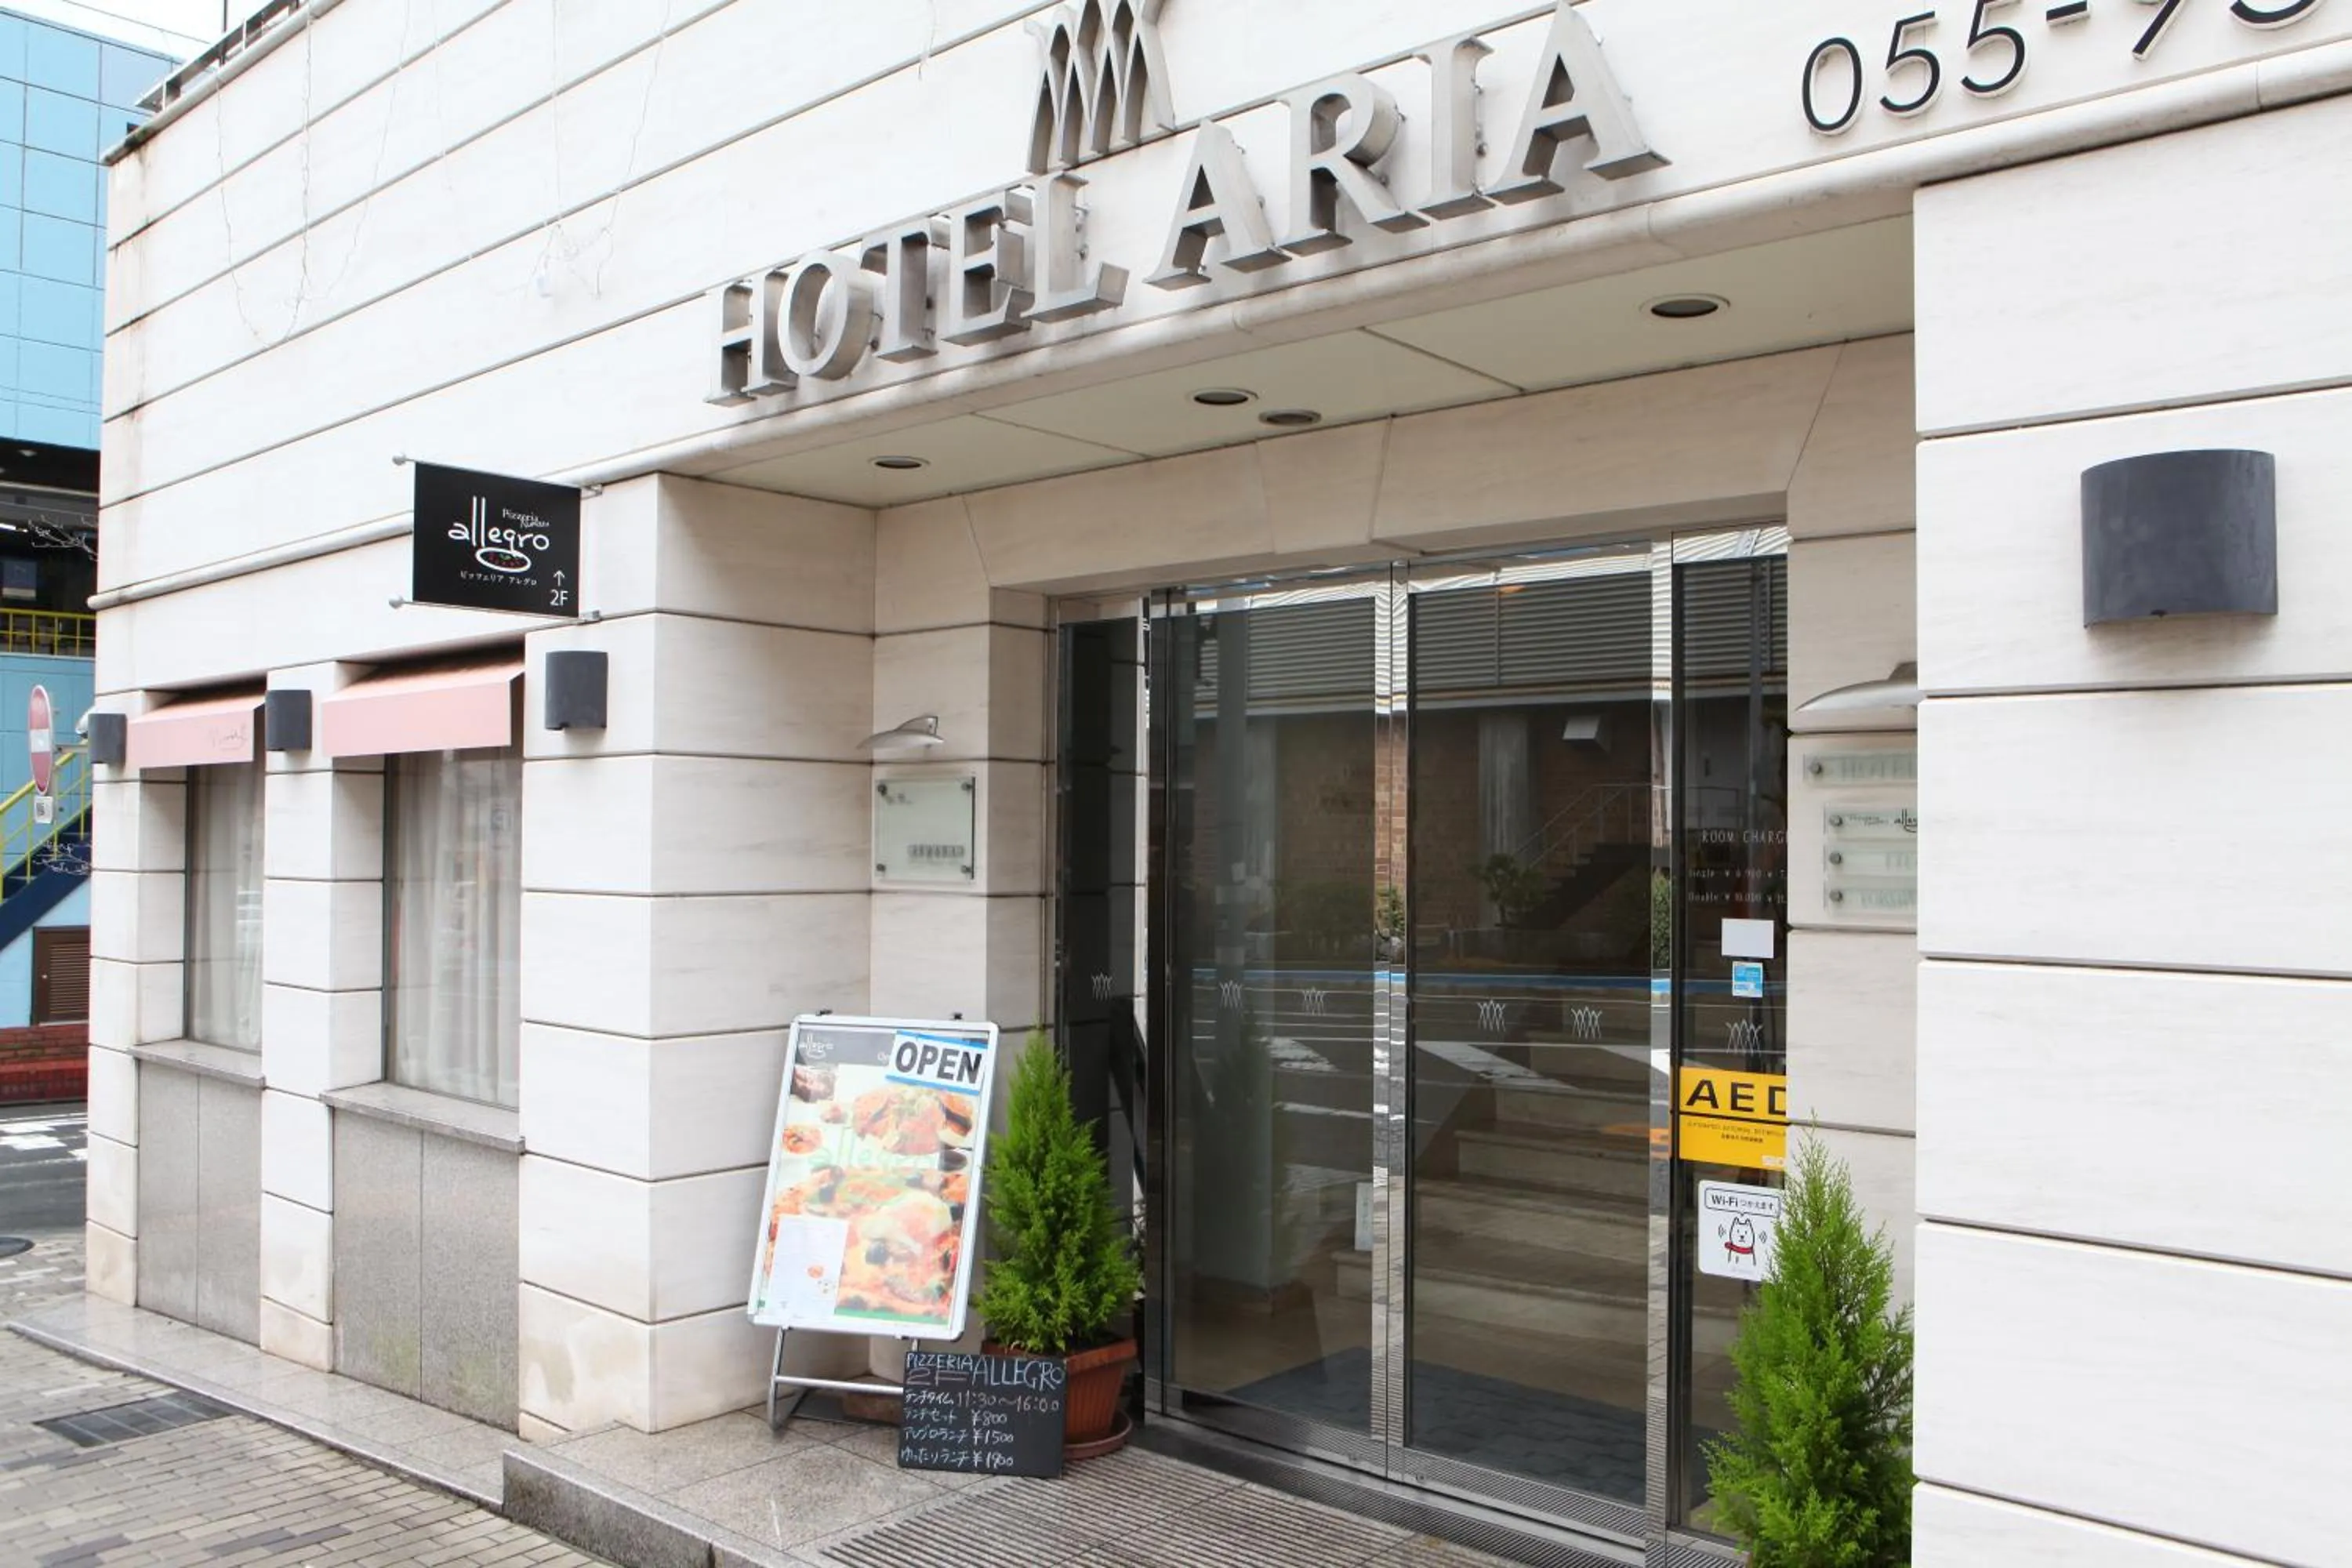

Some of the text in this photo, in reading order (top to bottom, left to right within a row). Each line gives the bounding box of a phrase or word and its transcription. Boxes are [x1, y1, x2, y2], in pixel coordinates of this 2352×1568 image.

[1802, 0, 2325, 136] 055-
[705, 2, 1671, 406] HOTEL ARIA
[448, 495, 550, 555] allegro
[550, 589, 569, 607] 2F
[1701, 829, 1788, 844] ROOM CHARG
[895, 1041, 983, 1084] OPEN
[1685, 1079, 1786, 1116] AED
[1711, 1194, 1738, 1207] Wi-Fi
[906, 1353, 1066, 1392] PIZZERIA ALLEGRO
[906, 1367, 971, 1387] 2F
